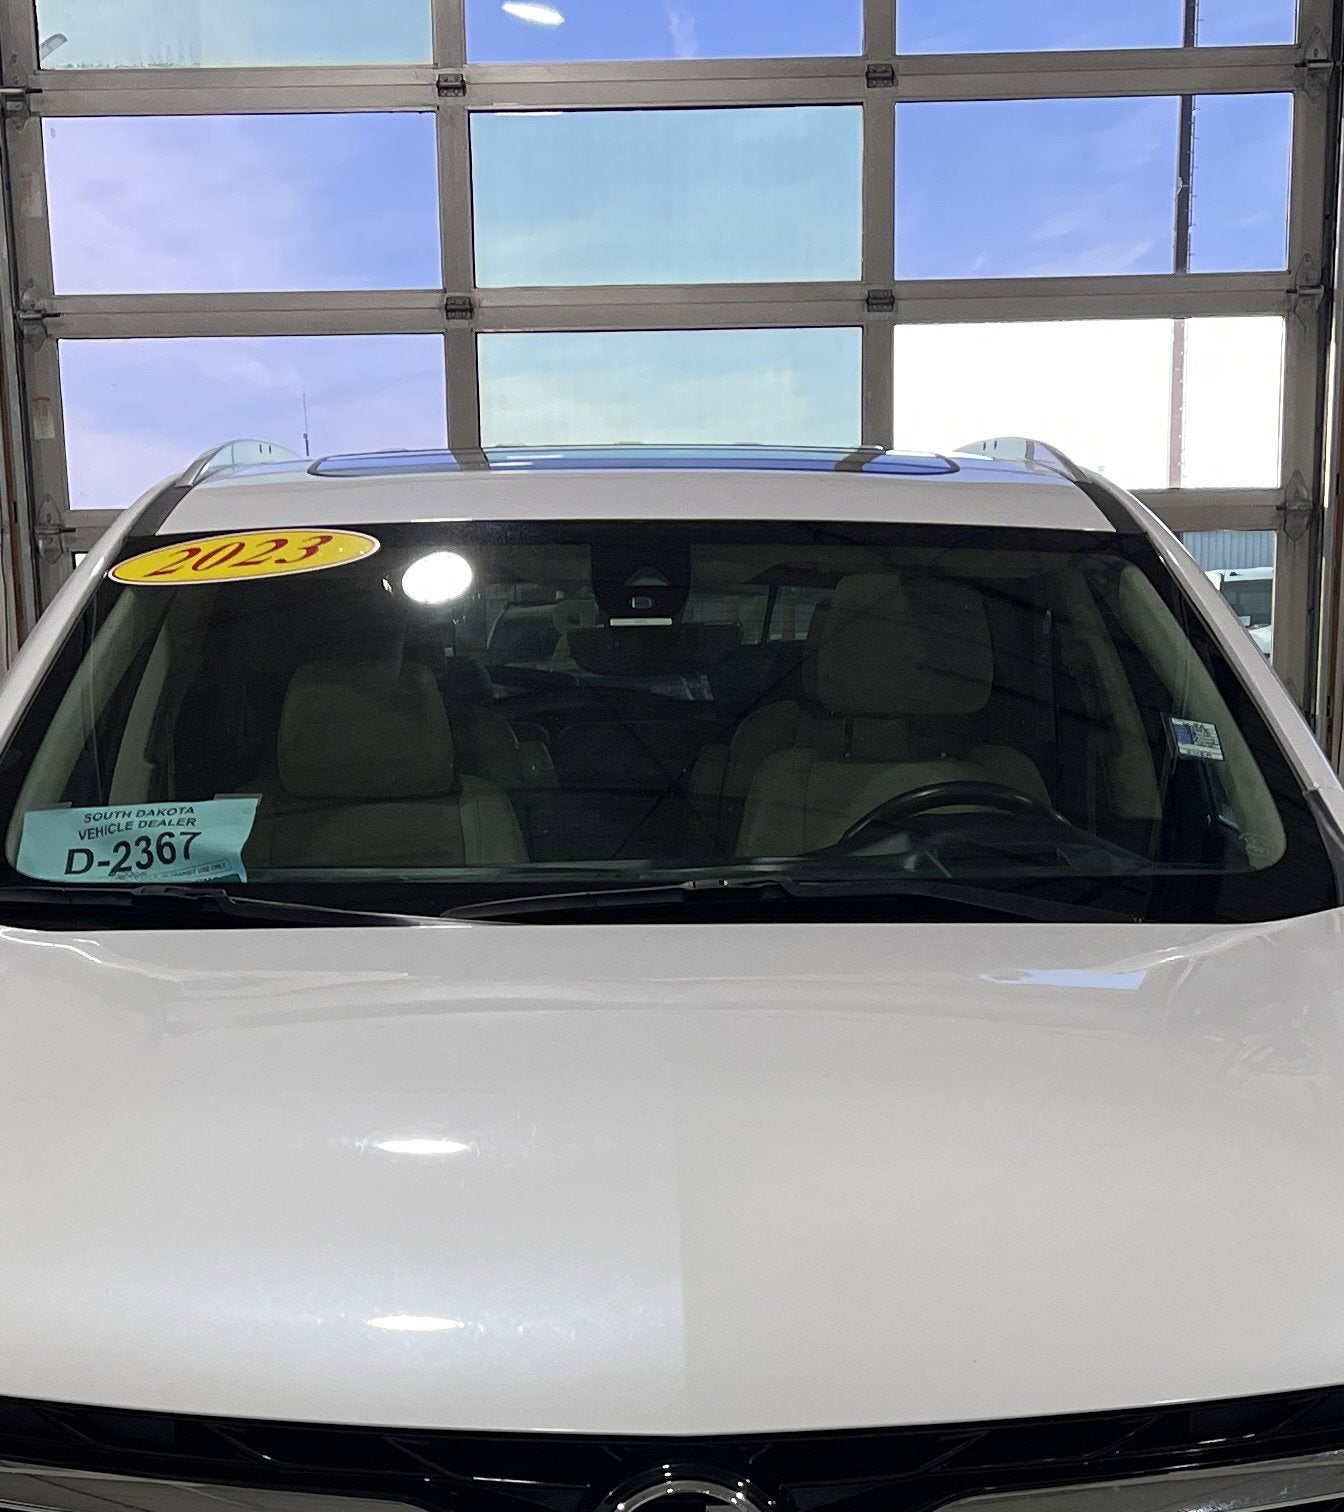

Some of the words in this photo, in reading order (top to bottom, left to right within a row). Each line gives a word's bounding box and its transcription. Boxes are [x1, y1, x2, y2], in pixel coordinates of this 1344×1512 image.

[143, 535, 333, 577] 2023
[78, 821, 134, 841] VEHICLE
[138, 817, 197, 829] DEALER
[84, 810, 132, 823] SOUTH
[136, 806, 195, 818] DAKOTA
[64, 832, 202, 876] D-2367
